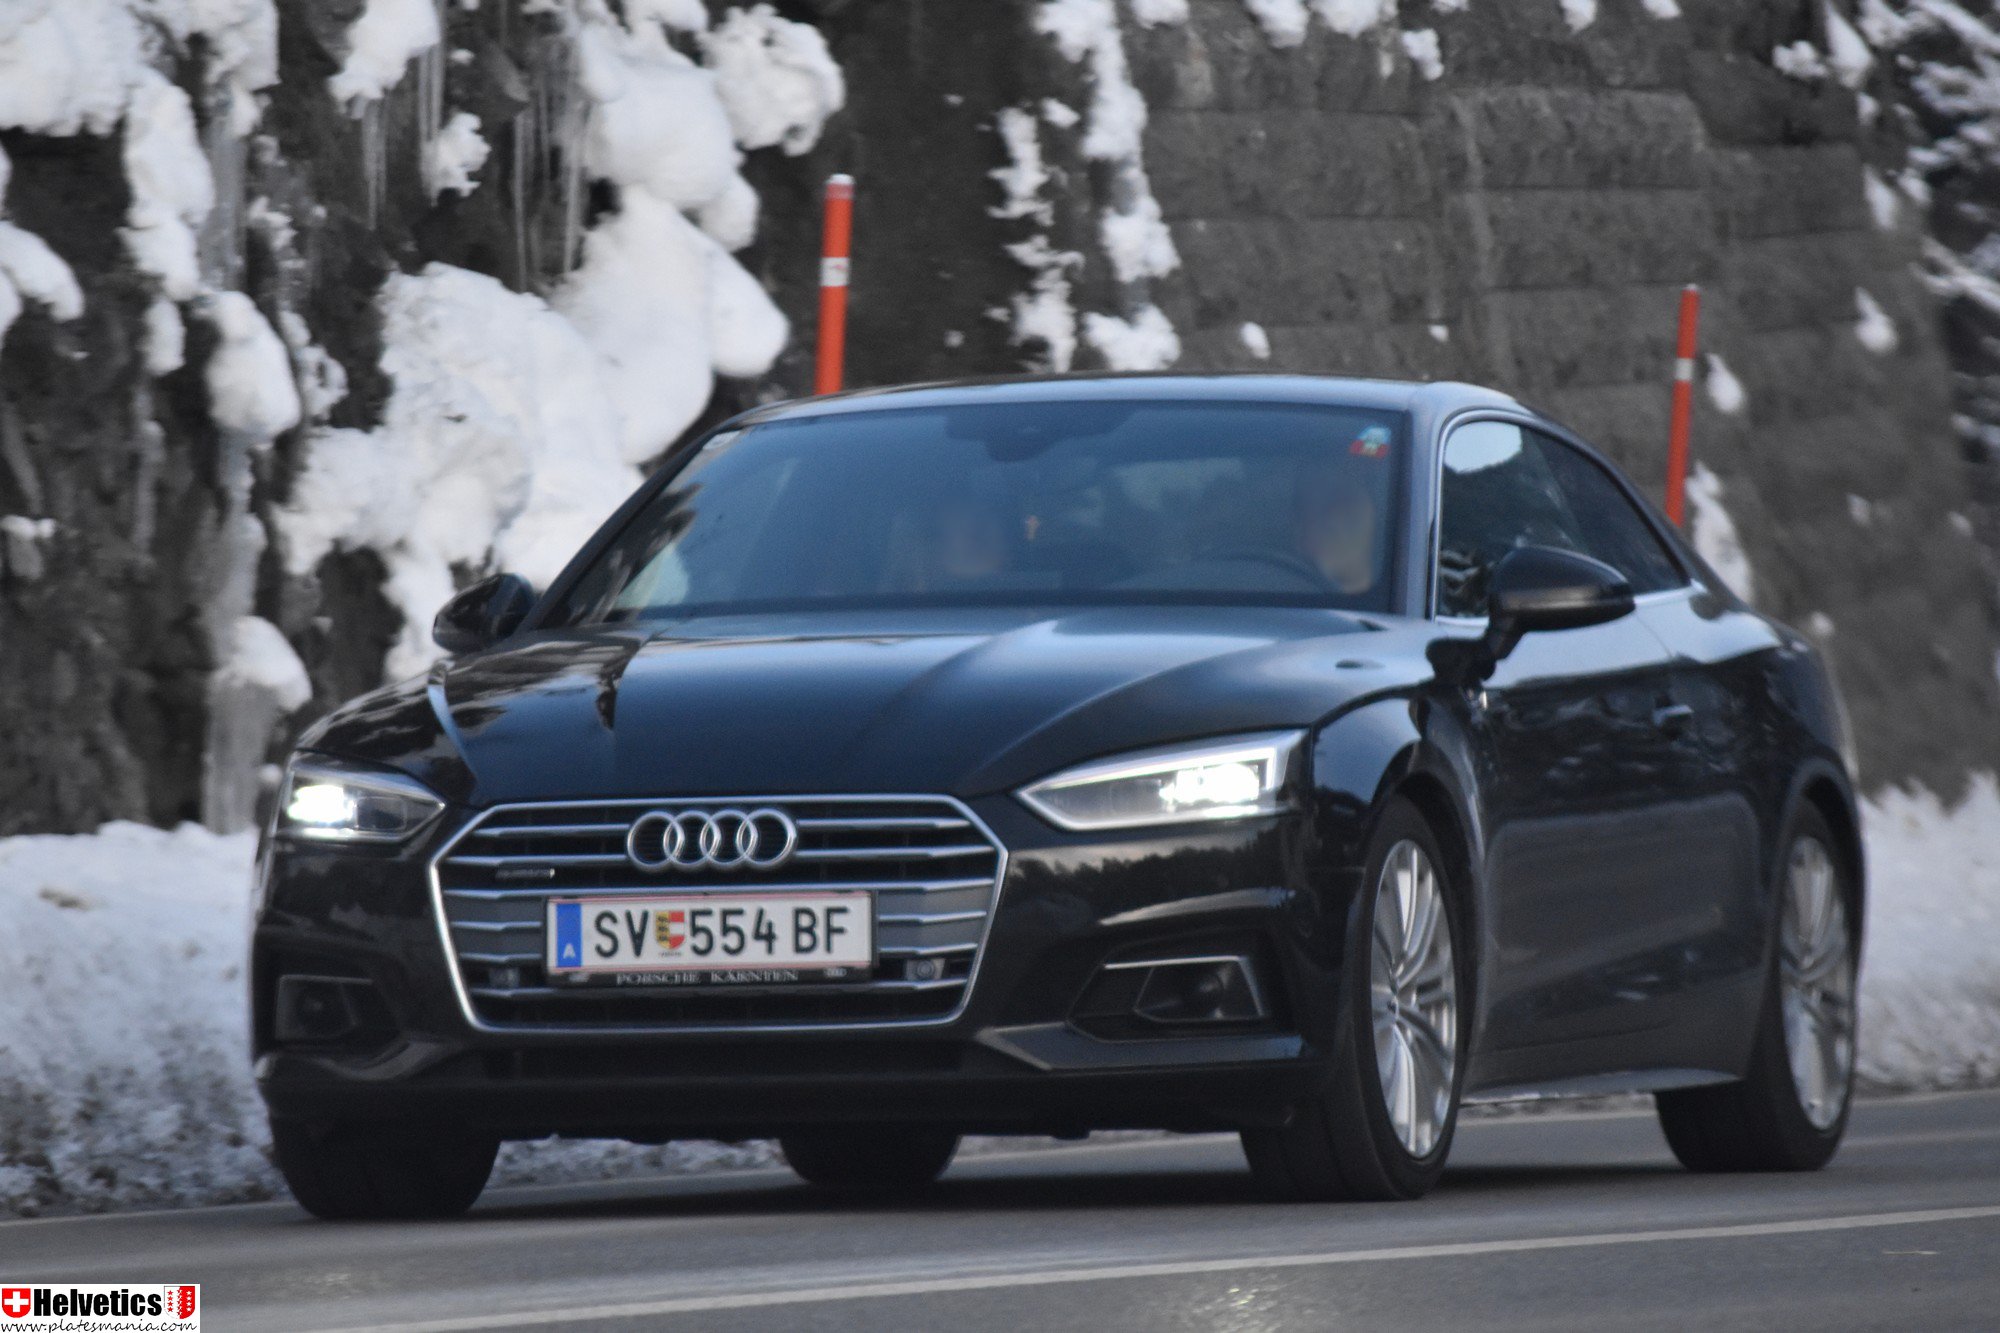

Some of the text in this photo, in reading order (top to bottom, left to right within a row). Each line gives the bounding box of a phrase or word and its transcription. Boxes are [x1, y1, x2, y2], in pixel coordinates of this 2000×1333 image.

[594, 906, 848, 958] SV 554 BF
[562, 943, 576, 959] A
[616, 972, 701, 986] PORSCHE
